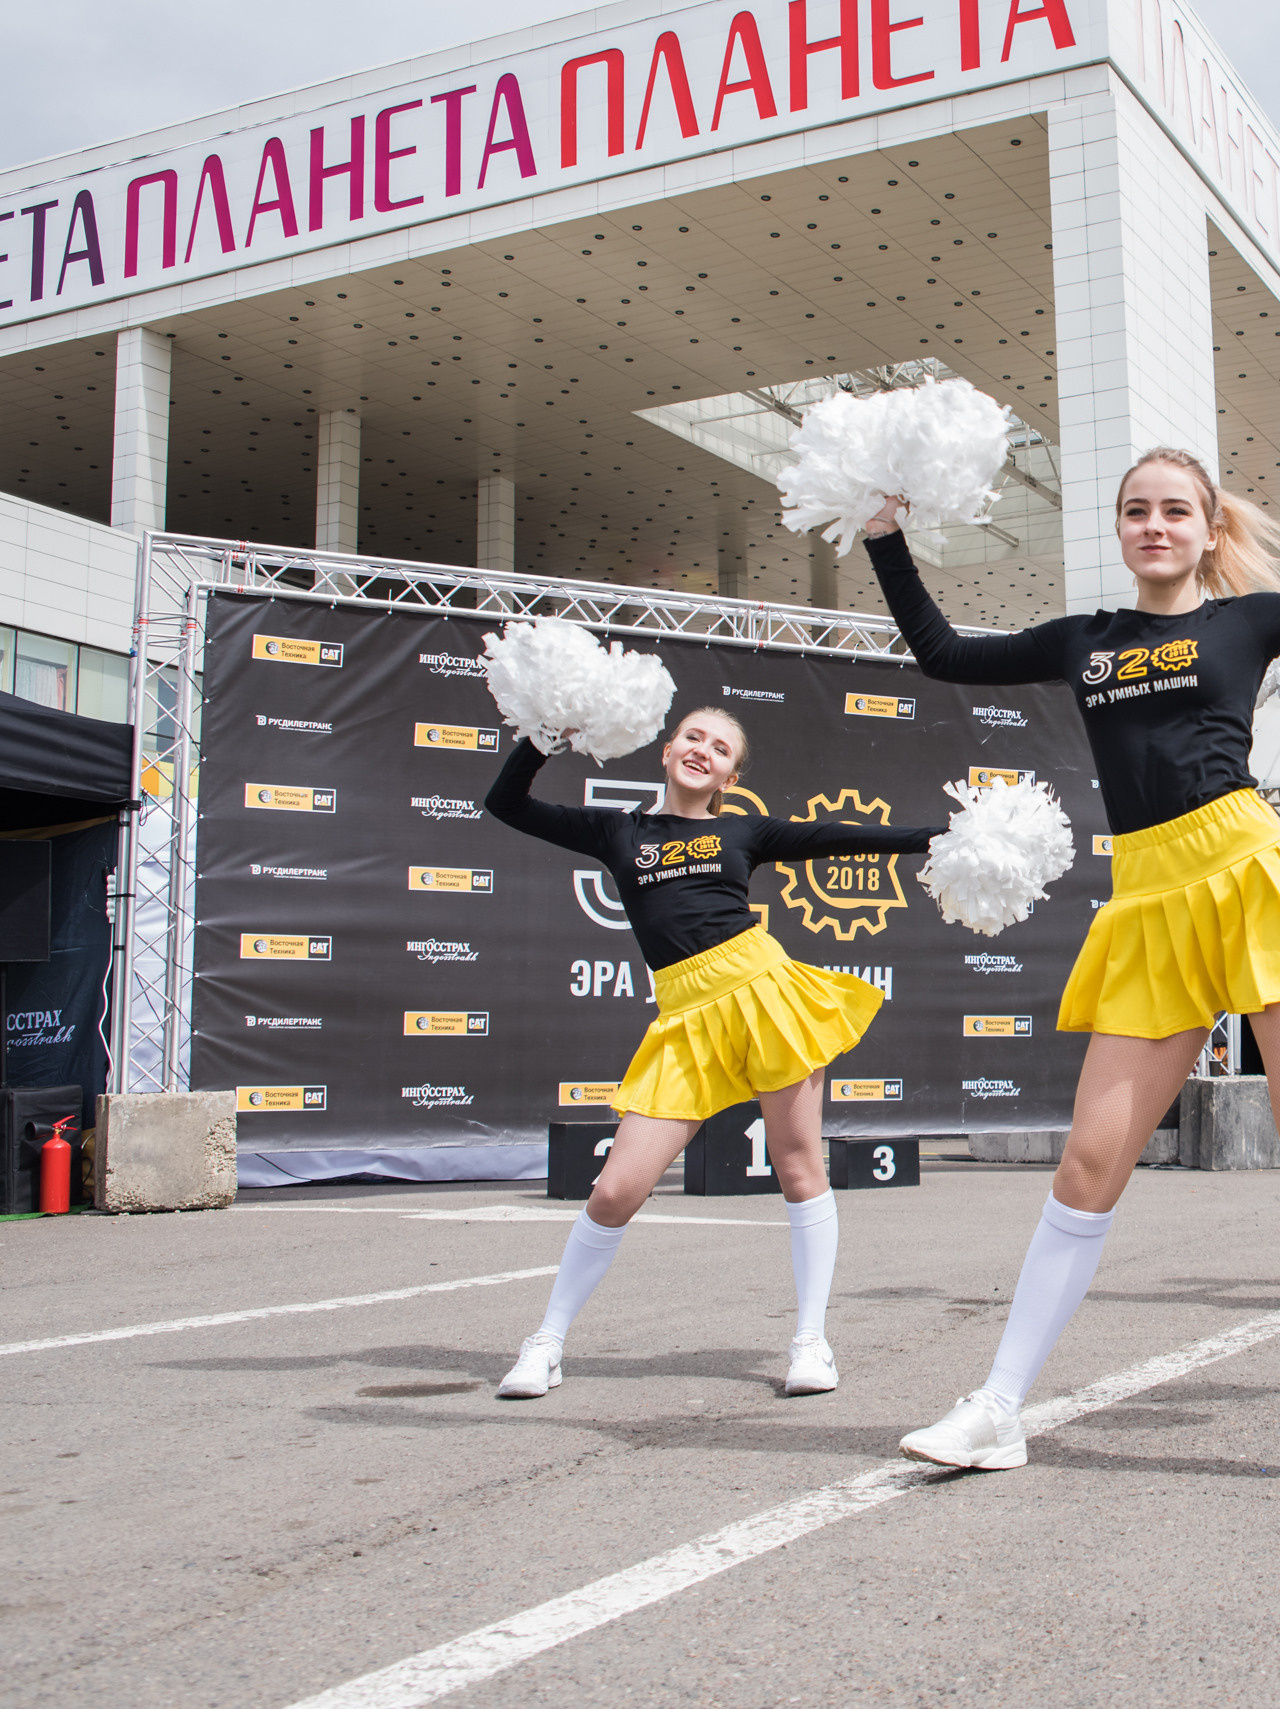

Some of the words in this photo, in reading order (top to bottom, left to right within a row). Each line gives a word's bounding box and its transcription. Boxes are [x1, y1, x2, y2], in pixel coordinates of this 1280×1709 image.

[124, 72, 538, 278] ПЛАНЕТА
[0, 189, 105, 309] ТА
[282, 643, 315, 652] Восточная
[281, 651, 307, 659] Техника
[321, 648, 340, 660] CAT
[732, 689, 784, 699] РУСДИЛЕРТРАНС
[1086, 692, 1106, 708] ЭРА
[1107, 682, 1151, 703] УМНЫХ
[1153, 675, 1198, 692] МАШИН
[898, 702, 912, 714] CAT
[973, 706, 1022, 719] ИНГОССТРАХ
[268, 718, 332, 730] РУСДИЛЕРТРАНС
[442, 729, 473, 737] Восточная
[479, 734, 496, 746] CAT
[274, 790, 308, 798] Восточная
[314, 794, 333, 806] CAT
[411, 797, 474, 810] ИНГОССТРАХ
[263, 867, 327, 876] РУСДИЛЕРТРАНС
[638, 874, 654, 885] ЭРА
[655, 866, 687, 882] УМНЫХ
[689, 864, 722, 874] МАШИН
[473, 875, 490, 887] CAT
[827, 867, 880, 892] 2018
[310, 942, 328, 954] CAT
[407, 941, 470, 952] ИНГОССТРАХ
[965, 956, 1016, 964] ИНГОССТРАХ
[570, 960, 634, 998] ЭРА
[7, 1010, 62, 1030] ССТРАХ
[258, 1018, 322, 1026] РУСДИЛЕРТРАНС
[469, 1018, 486, 1029] CAT
[1015, 1021, 1029, 1031] CAT
[885, 1084, 900, 1095] CAT
[962, 1080, 1014, 1090] ИНГОССТРАХ
[305, 1091, 324, 1104] CAT
[402, 1086, 465, 1097] ИНГОССТРАХ
[744, 1118, 772, 1176] 1
[872, 1145, 896, 1181] 3
